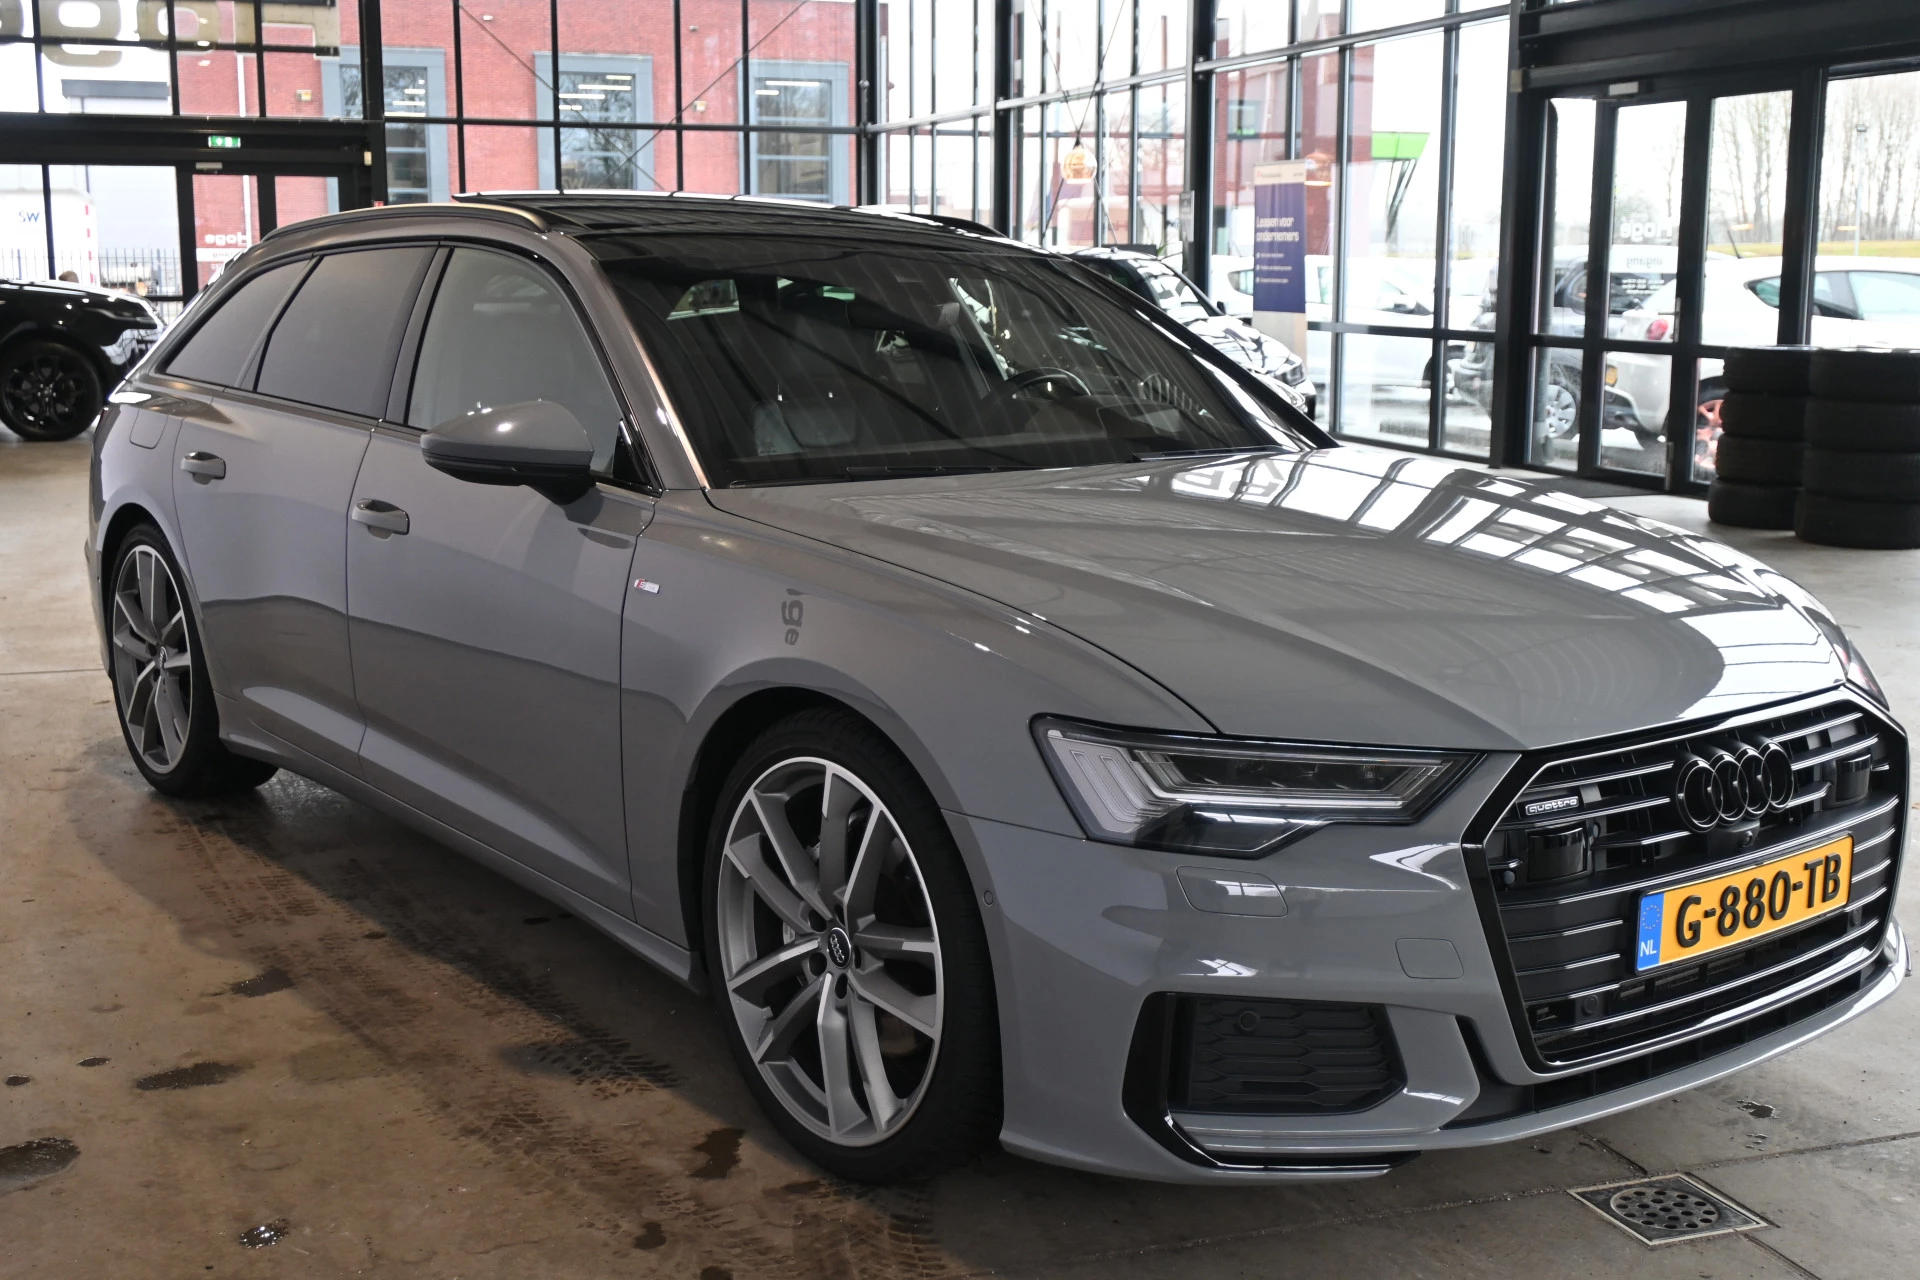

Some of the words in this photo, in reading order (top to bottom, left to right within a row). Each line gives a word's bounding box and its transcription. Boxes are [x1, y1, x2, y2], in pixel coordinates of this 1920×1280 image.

[1279, 217, 1295, 228] voor
[1529, 798, 1577, 813] quattro
[1676, 853, 1842, 948] G-880-TB
[1640, 939, 1657, 957] NL
